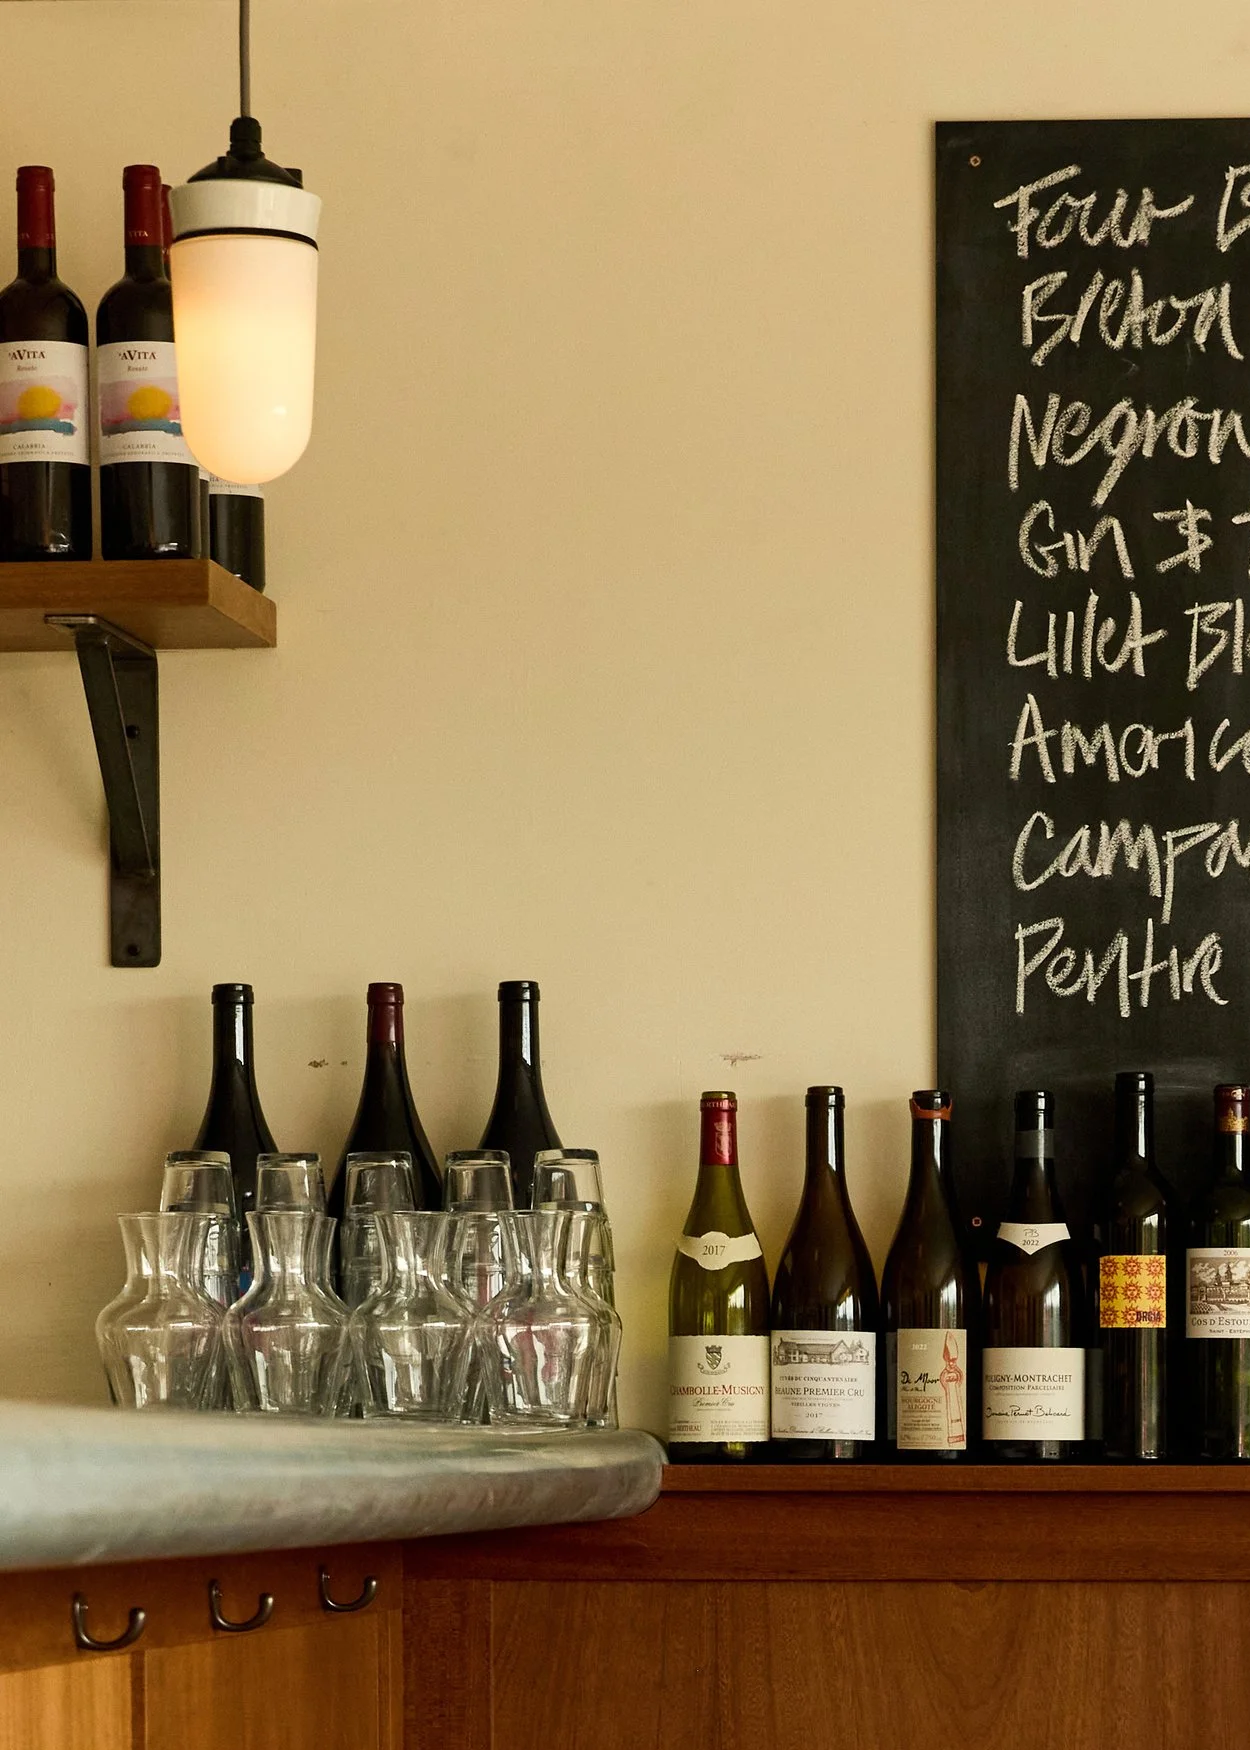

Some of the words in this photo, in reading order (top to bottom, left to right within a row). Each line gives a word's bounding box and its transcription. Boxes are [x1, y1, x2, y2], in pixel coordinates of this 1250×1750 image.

[994, 164, 1194, 258] Four
[1018, 499, 1135, 579] Gin
[702, 1245, 726, 1256] 2017
[1191, 1317, 1208, 1326] COS
[803, 1387, 846, 1396] PREMIER
[847, 1388, 864, 1396] CRU
